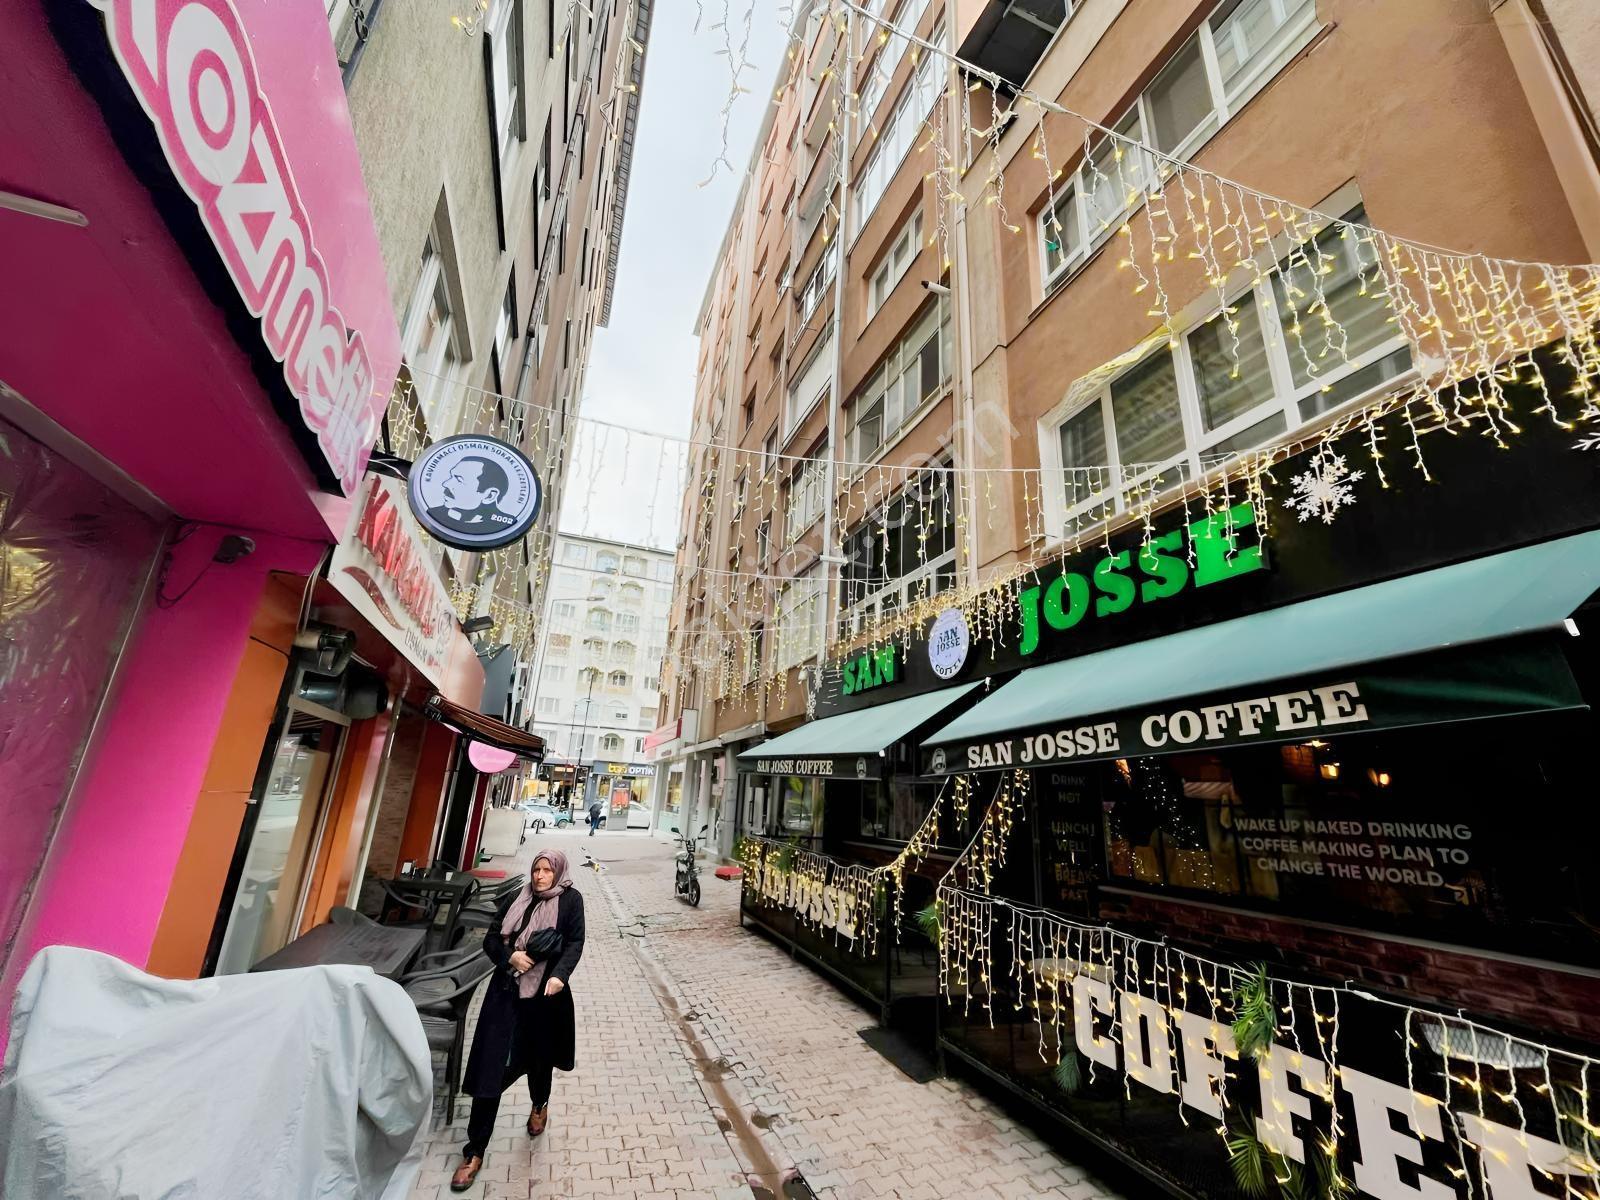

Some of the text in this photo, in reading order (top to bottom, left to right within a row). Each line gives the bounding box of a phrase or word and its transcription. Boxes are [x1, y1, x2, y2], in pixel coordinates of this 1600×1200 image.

[457, 443, 489, 451] OSMAN
[492, 514, 515, 525] 2002
[842, 502, 1267, 696] SAN JOSSE
[938, 626, 959, 643] SAN
[936, 637, 961, 656] JOSSE
[967, 739, 1013, 770] SAN
[1019, 721, 1121, 764] JOSSE
[1140, 681, 1369, 749] COFFEE
[756, 759, 833, 775] SAN JOSSE COFFEE
[1051, 773, 1086, 786] DRINK
[1058, 791, 1081, 804] HOT
[1234, 817, 1473, 841] WAKE UP NAKED DRINKING
[1242, 837, 1470, 865] COFFEE MAKING PLAN TO
[1257, 857, 1444, 887] CHANGE THE WORLD
[785, 870, 857, 940] JOSSE
